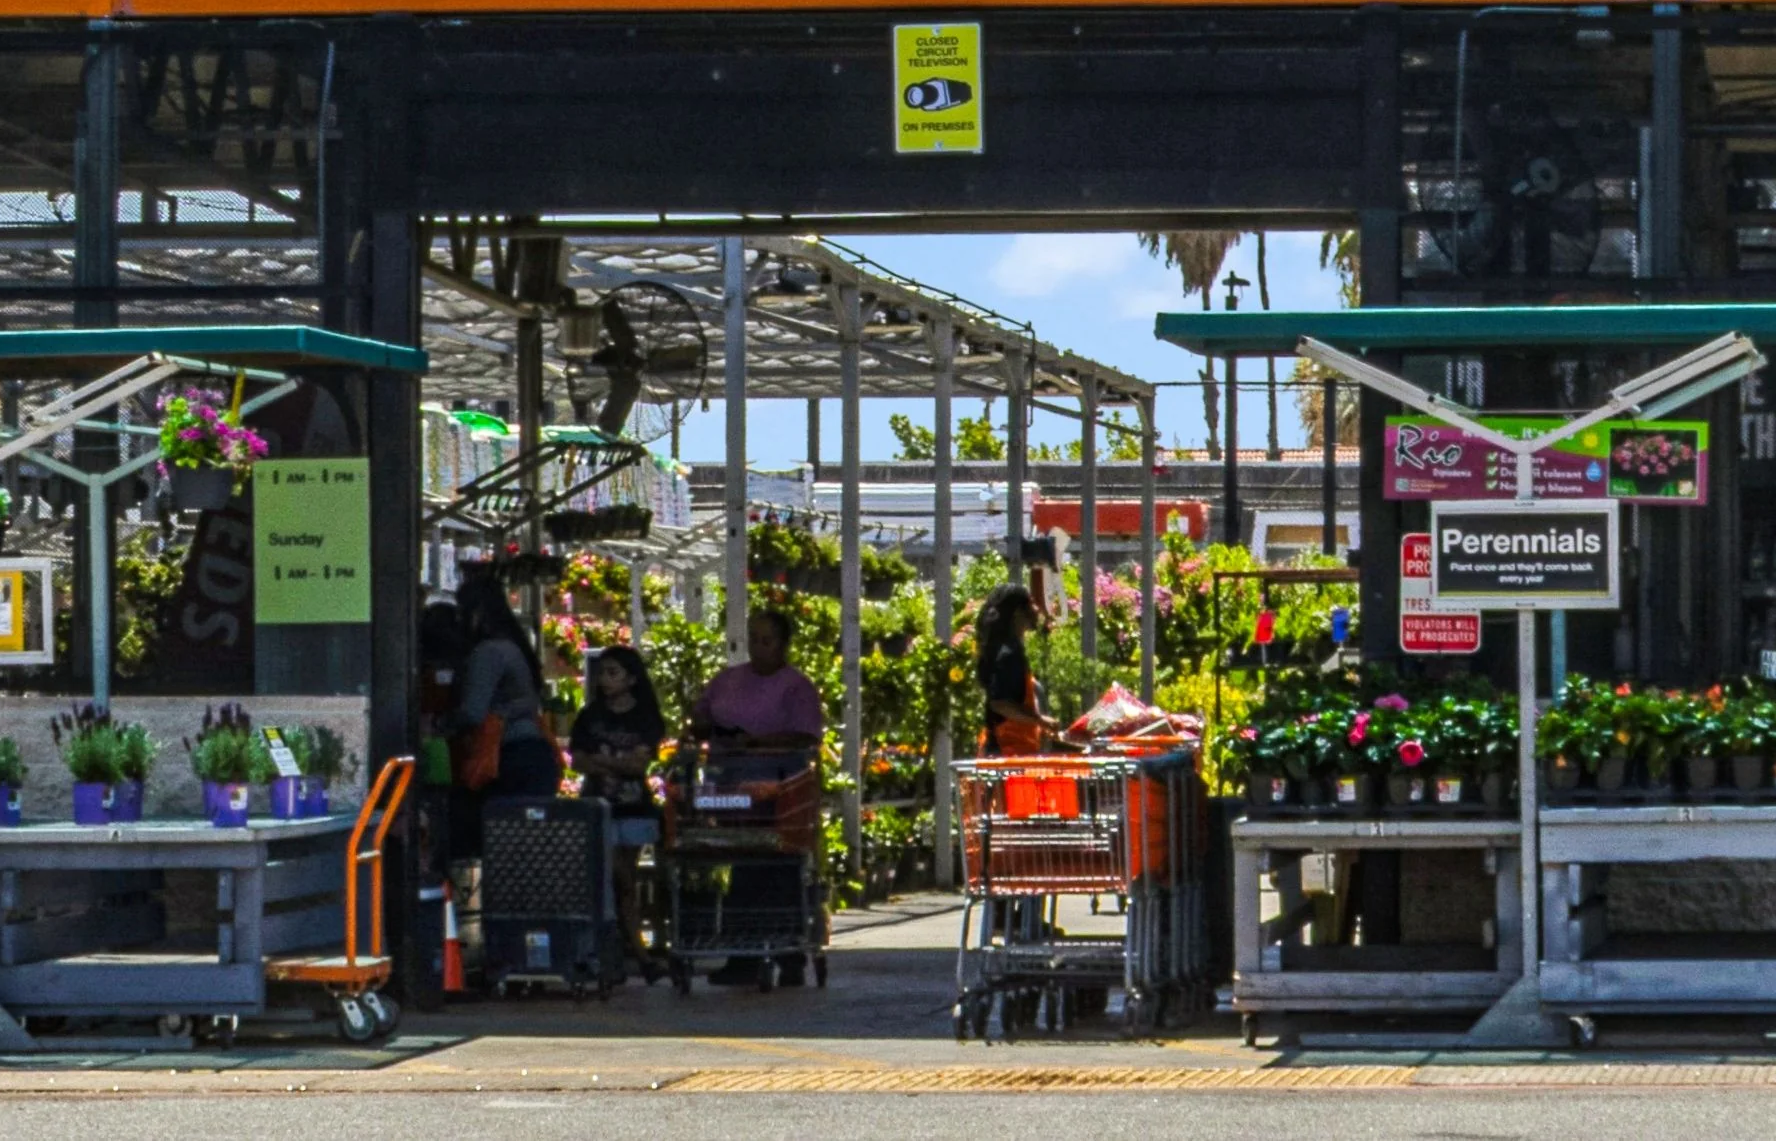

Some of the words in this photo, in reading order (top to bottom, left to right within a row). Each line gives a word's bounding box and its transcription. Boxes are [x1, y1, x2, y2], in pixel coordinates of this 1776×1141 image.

[916, 37, 959, 46] CLOSED
[916, 47, 958, 57] CIRCUIT
[907, 57, 968, 67] TELEVISION
[903, 122, 918, 132] ON
[921, 121, 975, 131] PREMISES
[1395, 424, 1463, 469] Rio
[334, 471, 355, 483] PM
[1548, 483, 1584, 494] blooms
[268, 532, 324, 548] Sunday
[1442, 528, 1601, 554] Perennials
[335, 567, 356, 578] PM
[1449, 562, 1473, 572] Plant
[1474, 564, 1497, 572] once
[1498, 563, 1516, 571] and
[1544, 564, 1569, 572] come
[1571, 562, 1593, 572] back
[1498, 575, 1523, 584] every
[1524, 575, 1545, 584] year
[1404, 619, 1452, 630] VIOLATORS
[1456, 619, 1476, 629] WILL
[1404, 631, 1417, 642] BE
[1420, 631, 1476, 642] PROSECUTED
